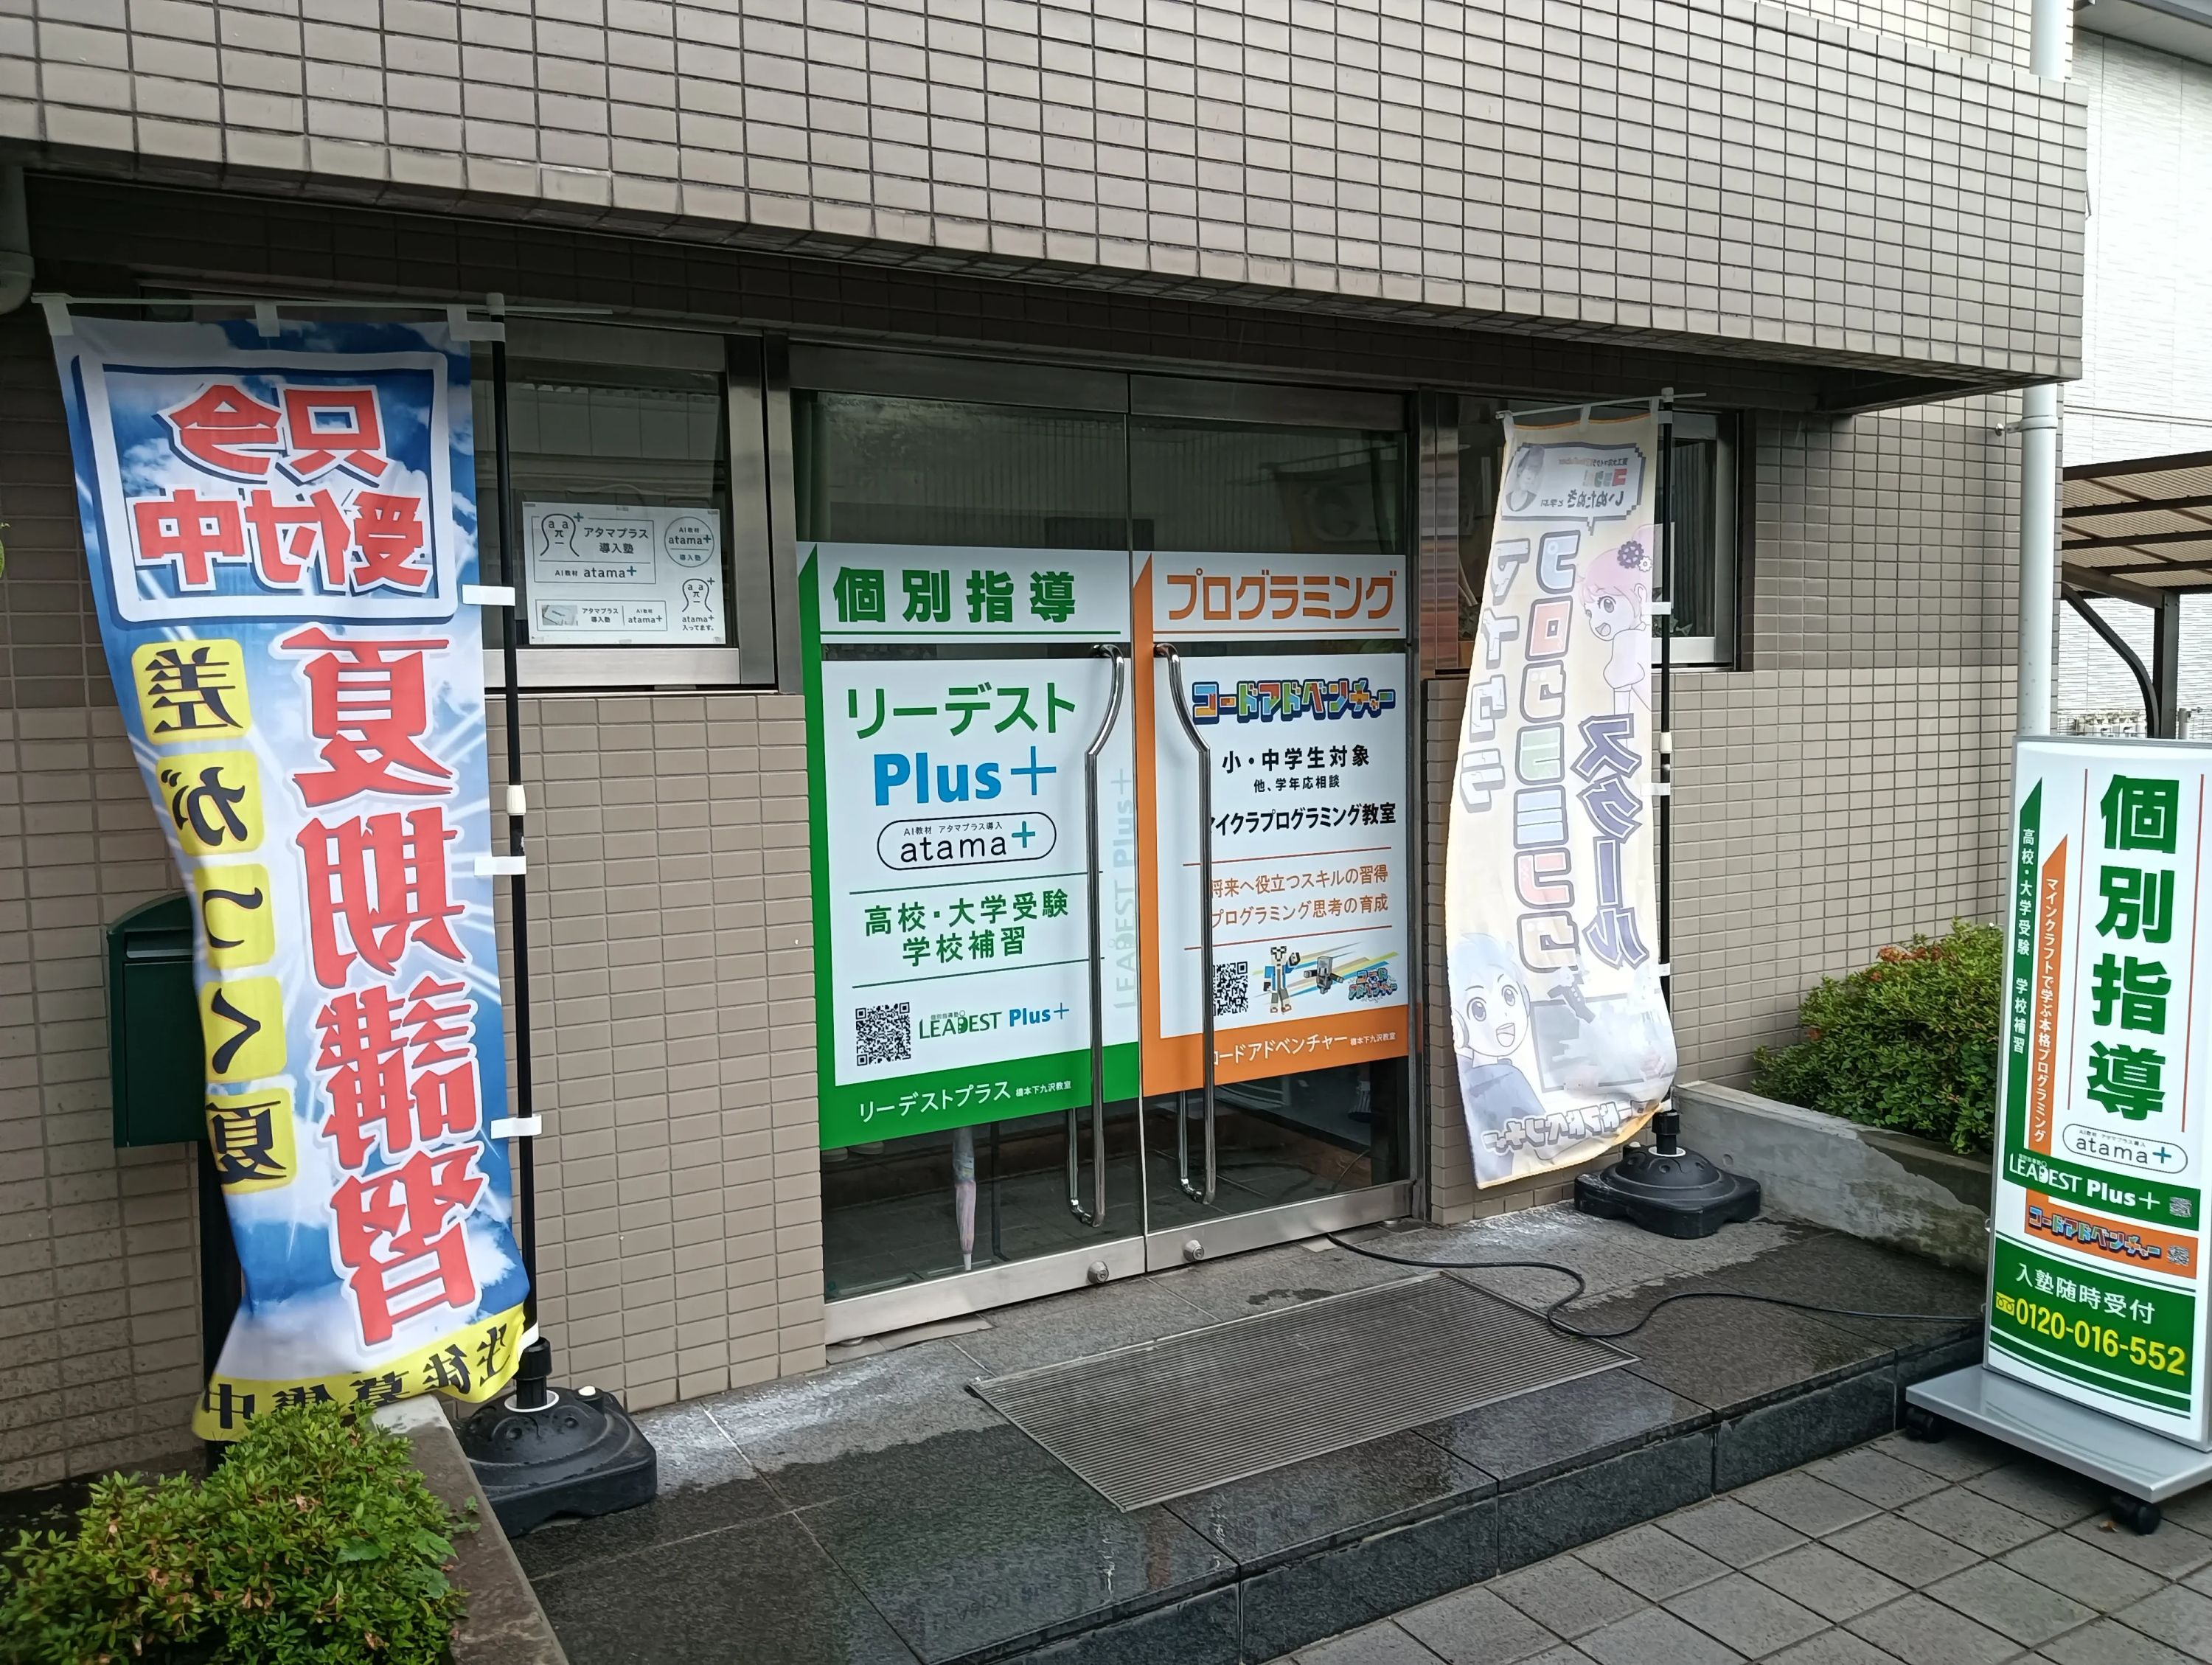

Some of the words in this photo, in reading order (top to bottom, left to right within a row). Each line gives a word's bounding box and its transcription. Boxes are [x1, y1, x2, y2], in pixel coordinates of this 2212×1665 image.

[583, 526, 649, 539] アタマプラス
[599, 543, 634, 555] 導入塾
[668, 535, 712, 545] atama+
[583, 566, 637, 578] atama+
[833, 566, 1076, 623] 個別指導
[1166, 567, 1398, 621] プログラミング
[847, 681, 1076, 739] リーデスト
[1192, 678, 1396, 725] コードアドベンチャー
[1222, 743, 1370, 774] 小・中学生対象
[1253, 774, 1341, 793] 他、学年応相談
[900, 820, 1036, 863] atama+
[903, 826, 933, 836] AI教材
[938, 821, 1003, 834] アタマプラス導入
[864, 889, 1069, 936] 高校・大学受験
[2017, 828, 2035, 956] 高校・大学受験
[902, 926, 1026, 967] 学校補習
[2087, 774, 2180, 1122] 個別指導
[2012, 977, 2028, 1054] 学校補習
[859, 1080, 1012, 1123] リーデストプラス
[2076, 1137, 2172, 1164] atama+
[2016, 1262, 2156, 1325] 入塾随時受付
[2016, 1298, 2186, 1377] 0120-016-552
